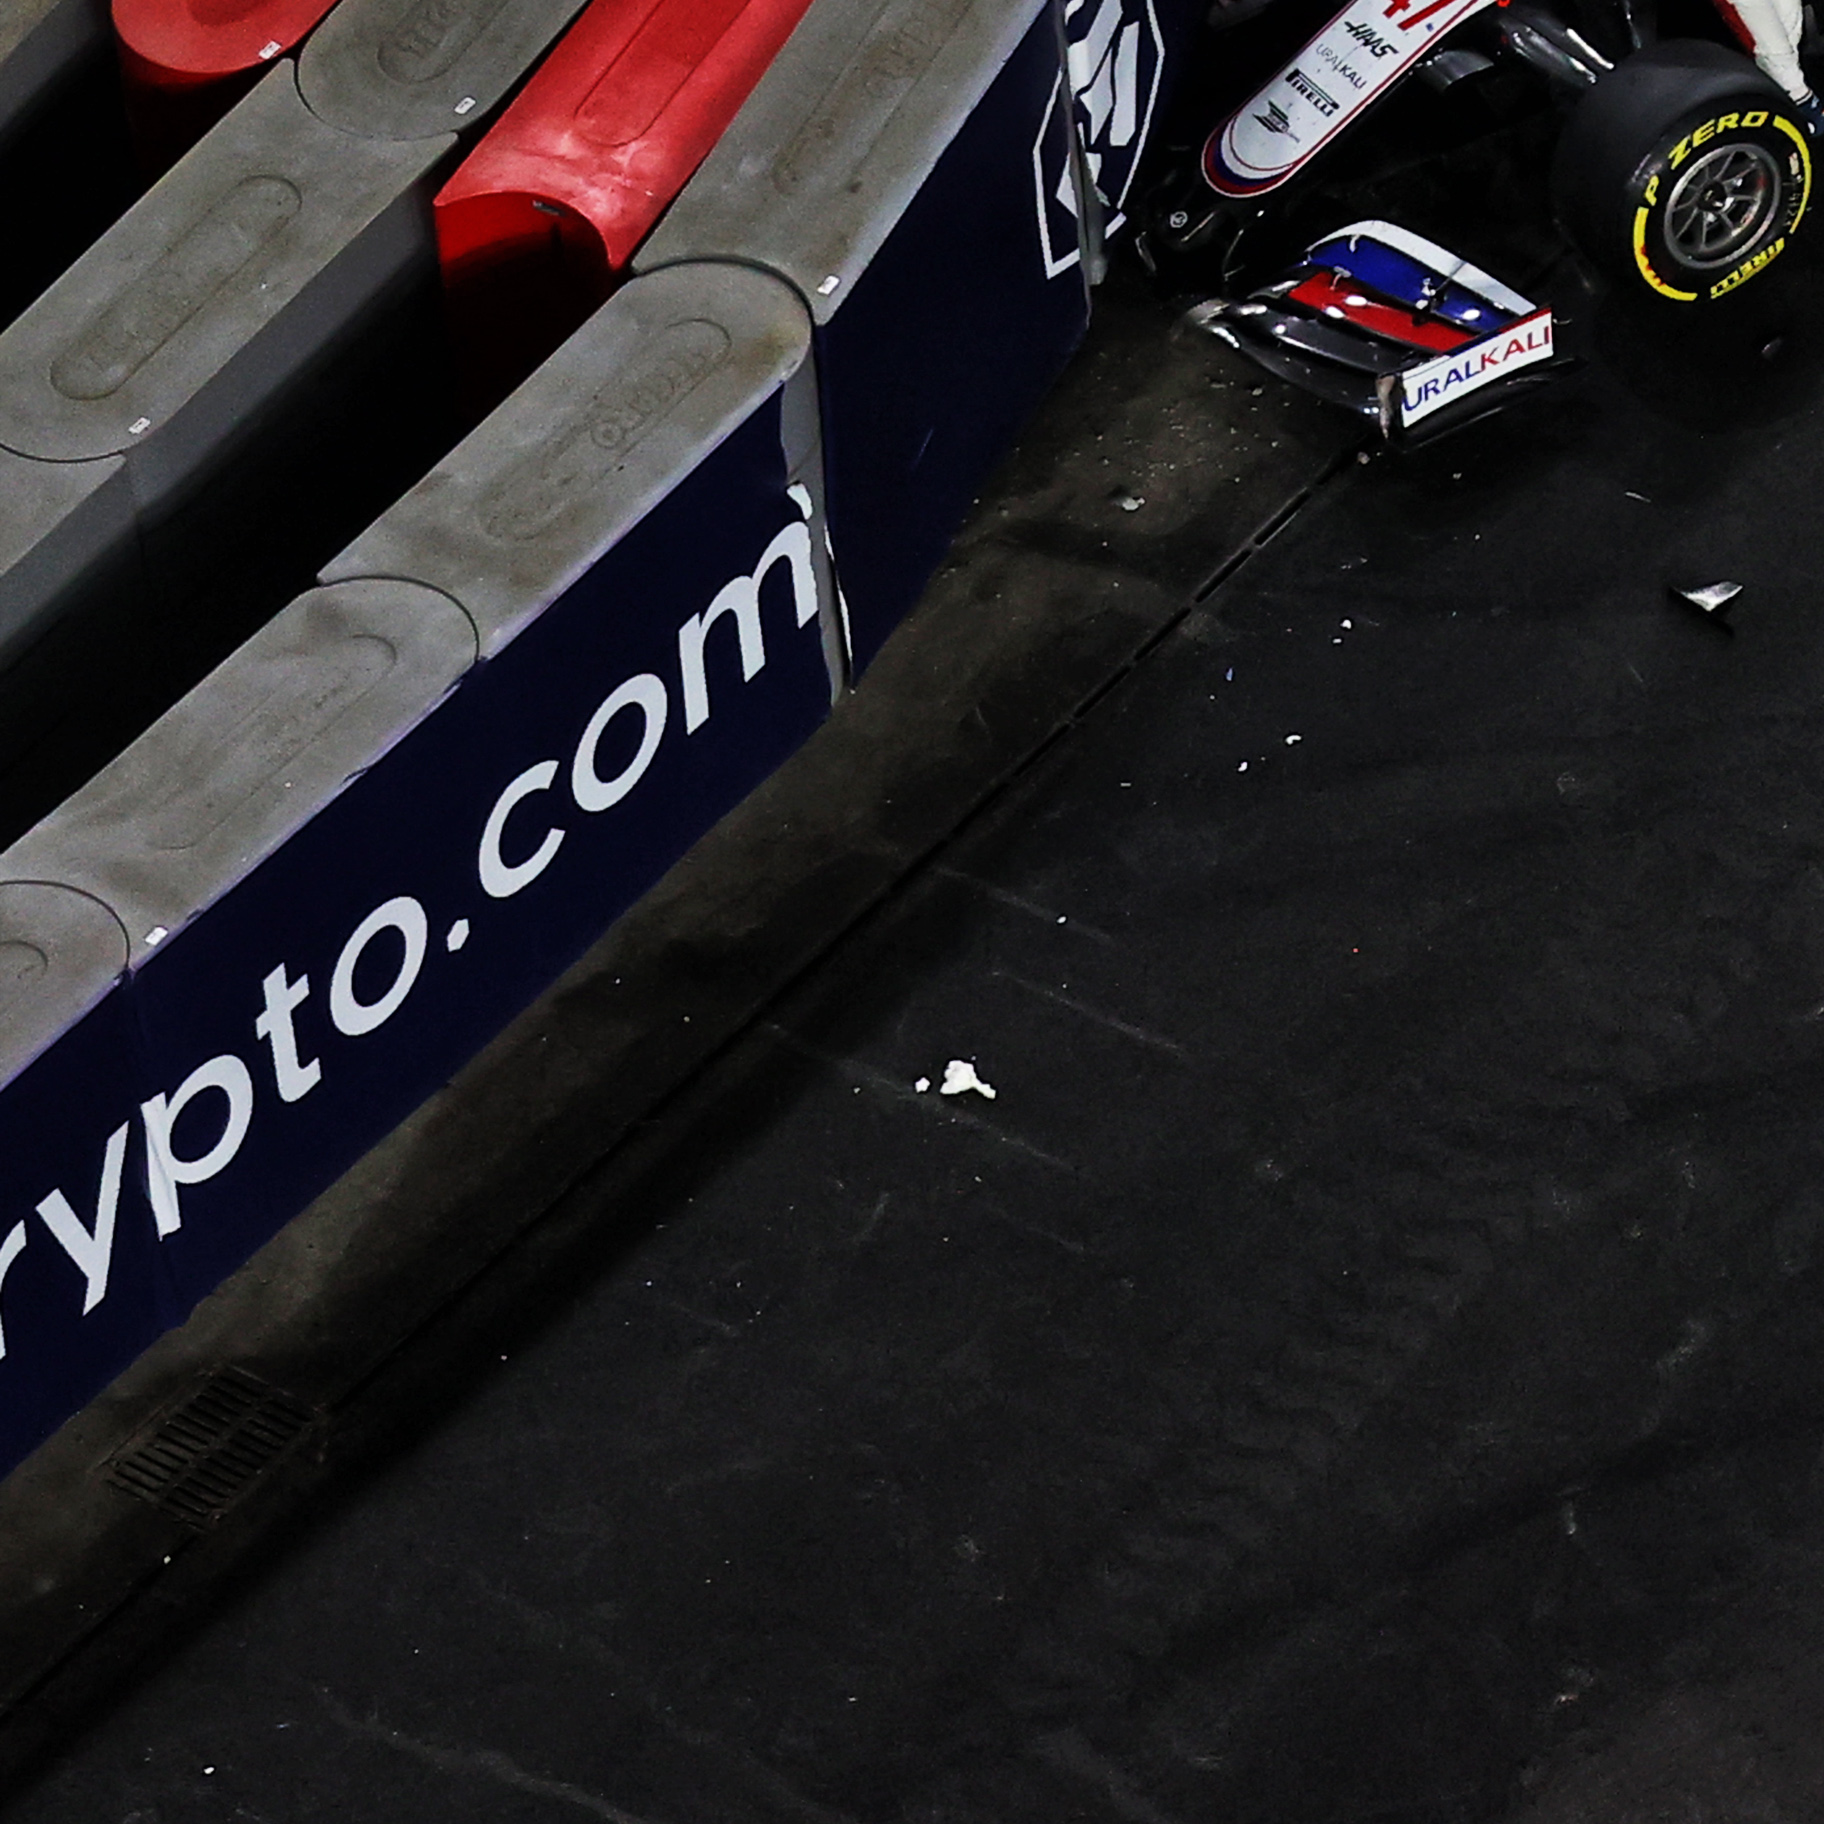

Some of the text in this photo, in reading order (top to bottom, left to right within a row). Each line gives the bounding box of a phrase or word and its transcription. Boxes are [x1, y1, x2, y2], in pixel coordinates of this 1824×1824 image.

[1345, 21, 1398, 59] HAAS
[1315, 43, 1366, 90] URALKALI
[1287, 69, 1339, 117] PIRELLI
[1644, 110, 1770, 207] P ZERO
[1402, 325, 1553, 413] URALKALI
